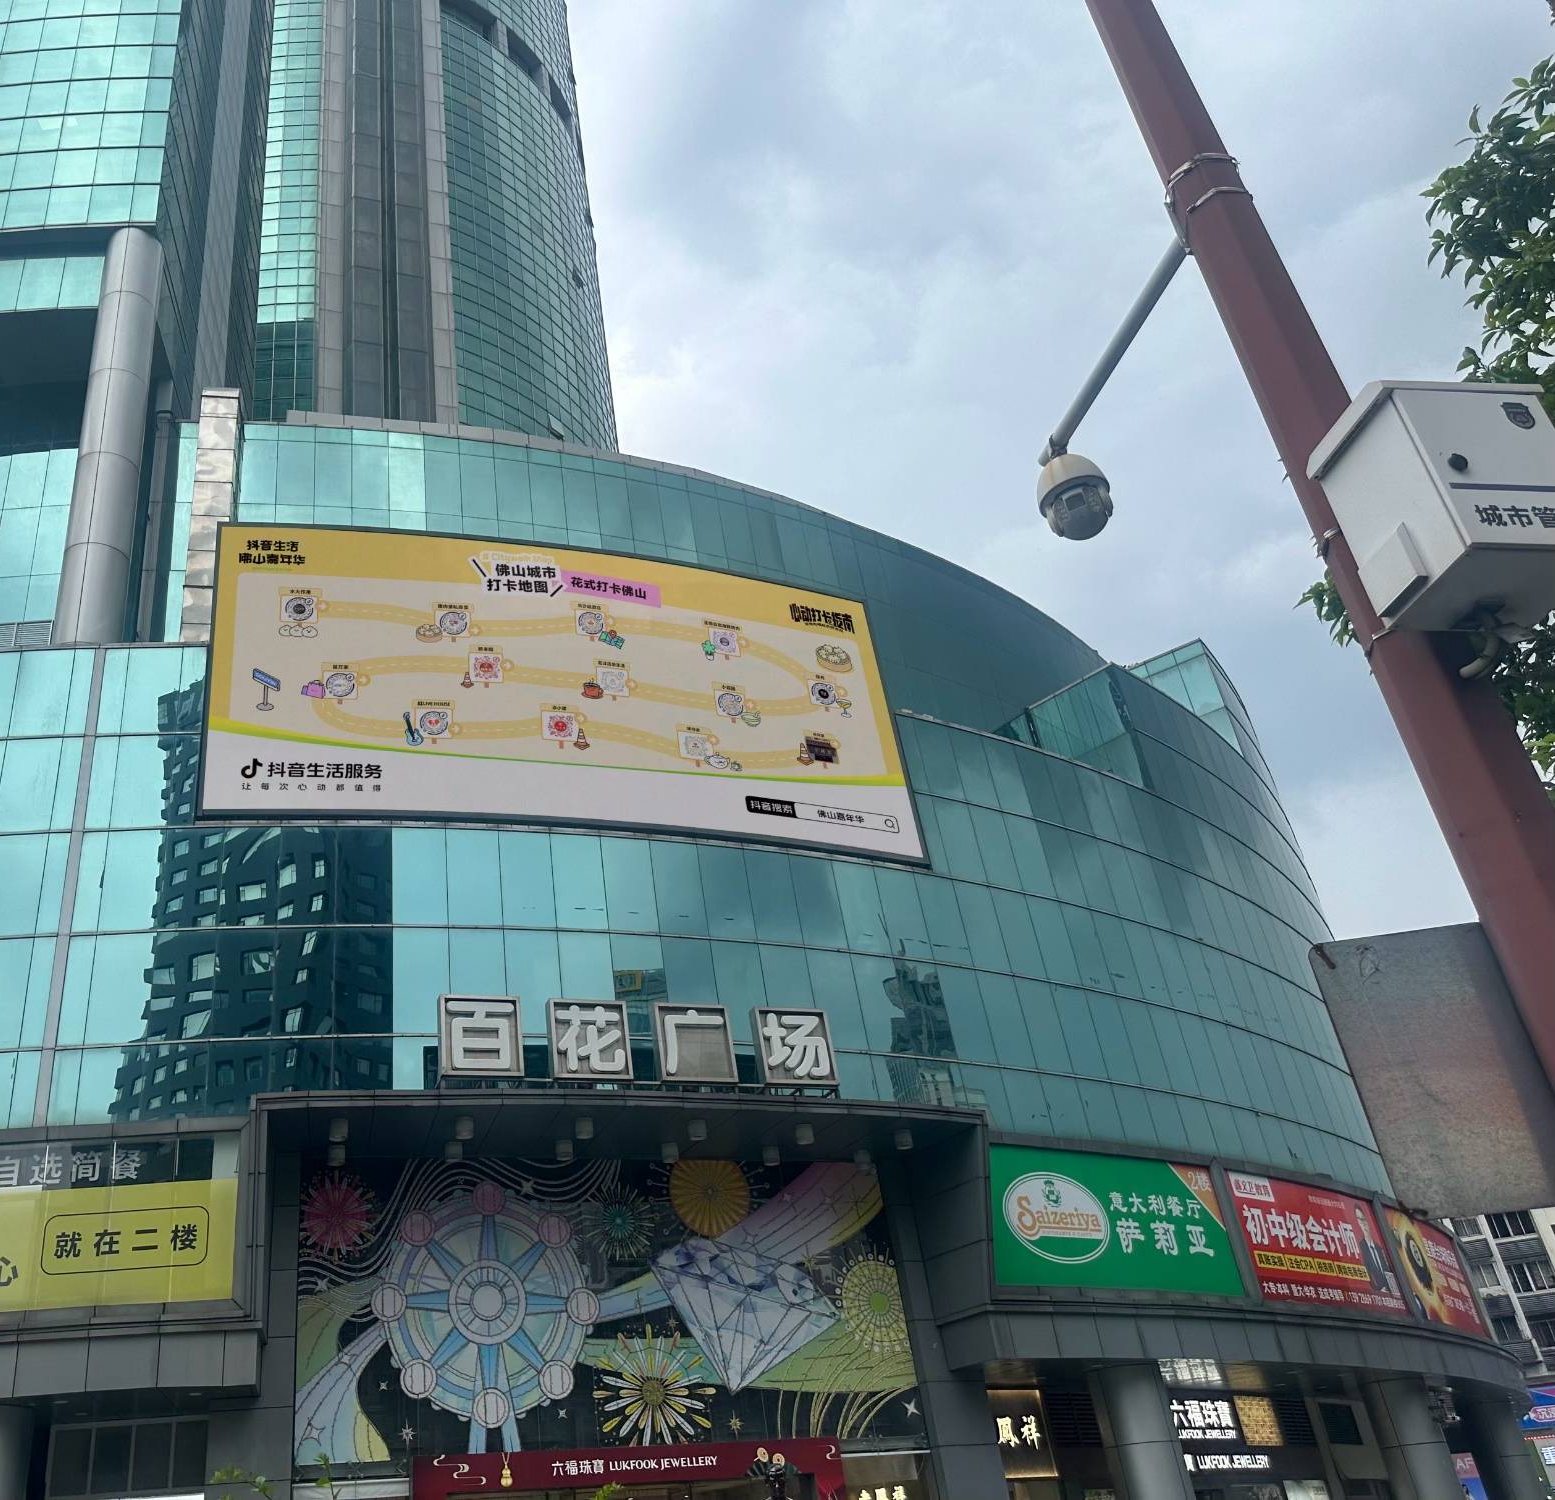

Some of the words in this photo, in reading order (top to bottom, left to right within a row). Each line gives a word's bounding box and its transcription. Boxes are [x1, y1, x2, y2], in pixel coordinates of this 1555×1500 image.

[1474, 504, 1555, 529] 城市管
[246, 539, 300, 553] 抖音生活
[238, 553, 306, 567] 佛山嘉年华
[495, 563, 556, 579] 佛山城市
[487, 578, 549, 594] 打卡地图
[570, 576, 647, 600] 花式打卡佛山
[789, 603, 856, 634] 心动打卡指南
[267, 761, 383, 780] 抖音生活服务
[750, 799, 794, 815] 抖音搜索
[817, 809, 865, 825] 佛山嘉年华
[446, 1000, 832, 1079] 百花广场
[1188, 1171, 1212, 1193] 2楼
[1016, 1194, 1102, 1232] Saizeriya
[1108, 1191, 1201, 1220] 意大利餐厅
[53, 1223, 199, 1259] 就在二楼
[1115, 1217, 1215, 1258] 萨莉亚
[1170, 1399, 1234, 1427] 六福珠寶
[996, 1414, 1041, 1450] 鳳祥
[1178, 1429, 1204, 1439] LUKFOOK
[1204, 1429, 1237, 1439] JEWELLERY
[551, 1459, 605, 1476] 六福珠寶
[609, 1458, 659, 1473] LUKFOOK
[660, 1455, 718, 1471] JEWELLERY
[1196, 1455, 1232, 1469] LUKFOOK
[1232, 1455, 1270, 1469] JEWELLERY
